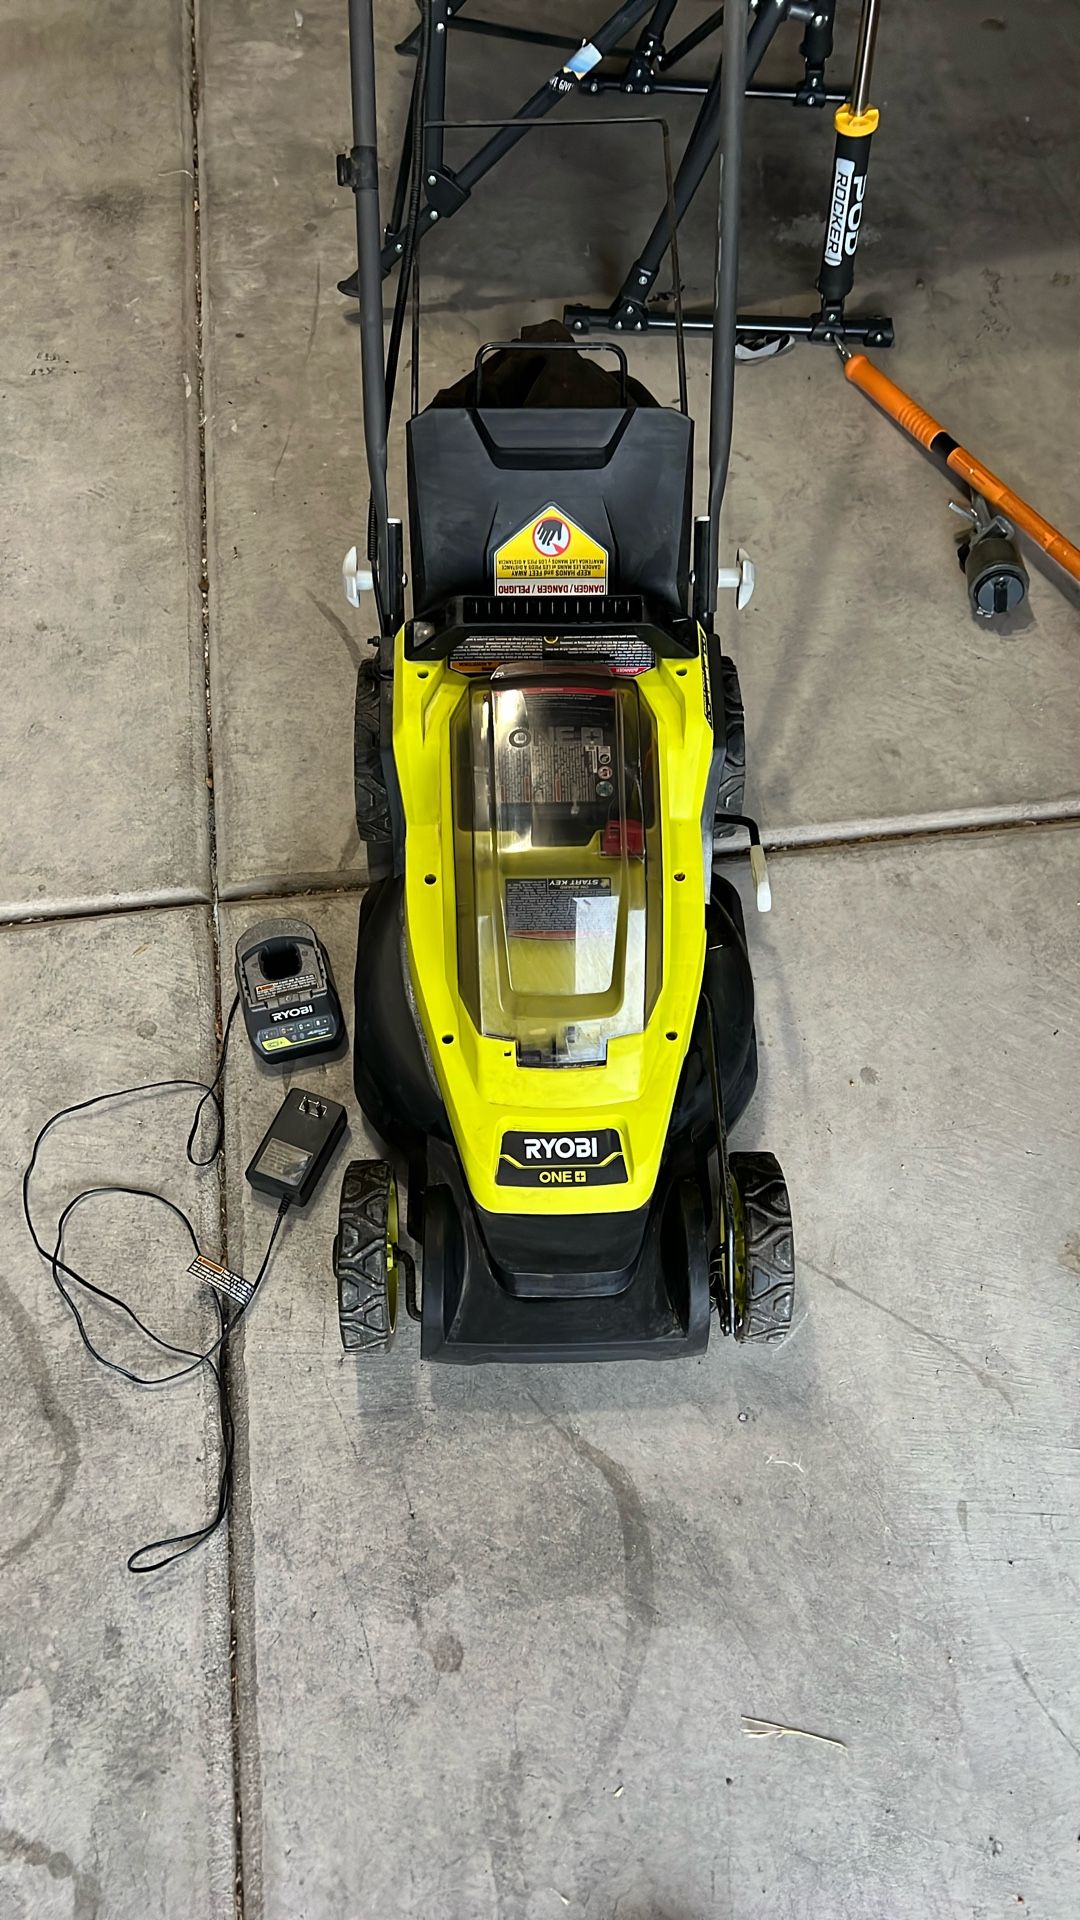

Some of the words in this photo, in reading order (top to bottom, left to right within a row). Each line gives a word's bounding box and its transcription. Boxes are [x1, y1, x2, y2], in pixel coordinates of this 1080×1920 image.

[828, 172, 848, 254] ROCKER
[844, 174, 867, 256] POD
[498, 585, 530, 594] PELIGRO
[537, 585, 569, 593] DANGER
[574, 585, 604, 593] DANGER
[271, 1004, 313, 1021] RYOBI
[524, 1138, 598, 1159] RYOBI
